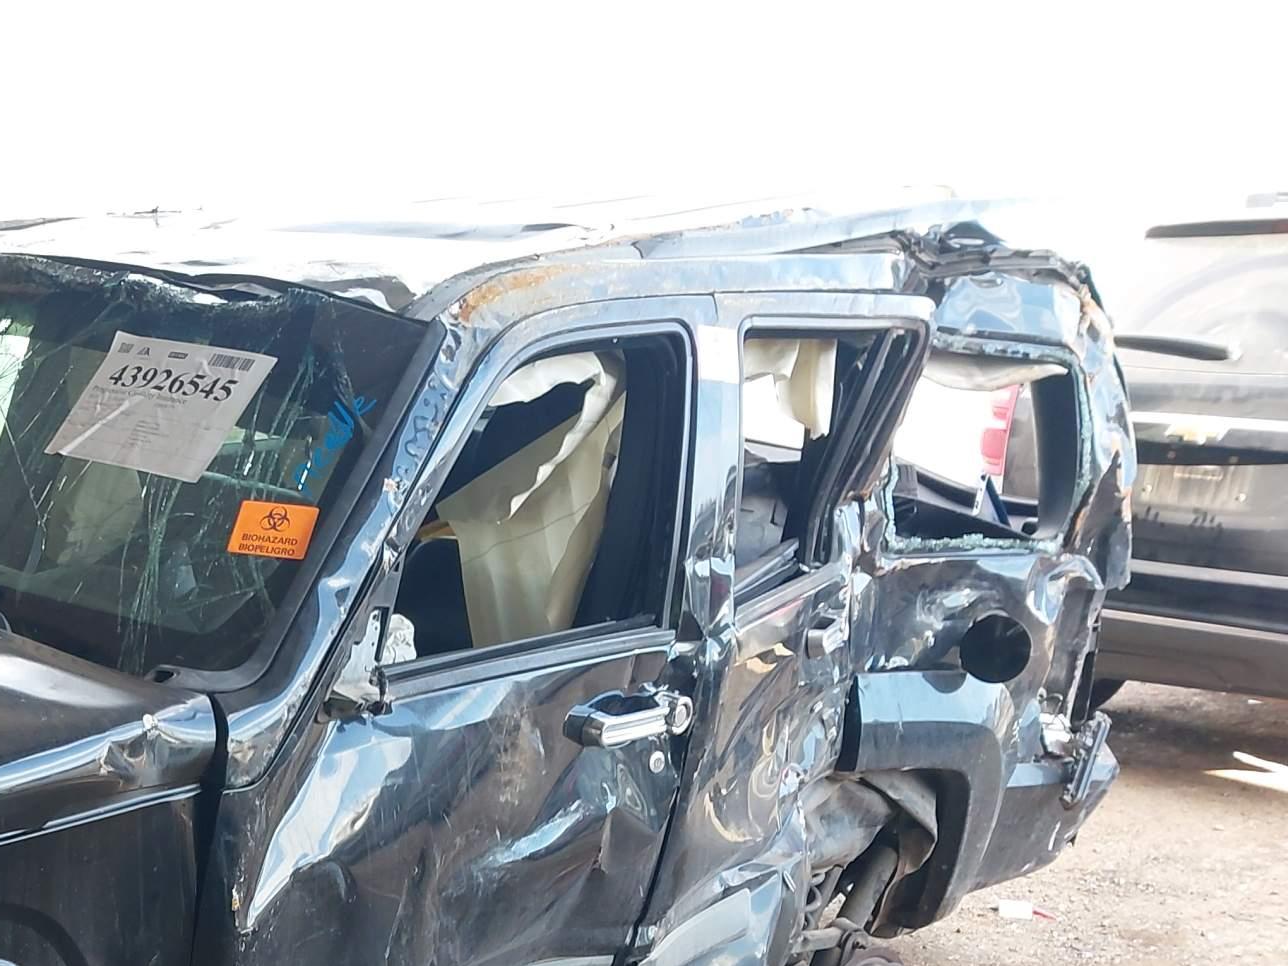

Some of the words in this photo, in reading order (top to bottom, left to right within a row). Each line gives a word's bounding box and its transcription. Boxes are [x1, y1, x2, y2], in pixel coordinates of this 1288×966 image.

[109, 365, 238, 402] 43926545
[242, 533, 298, 546] BIOHAZARD
[238, 543, 295, 556] BIOPELIGRO
